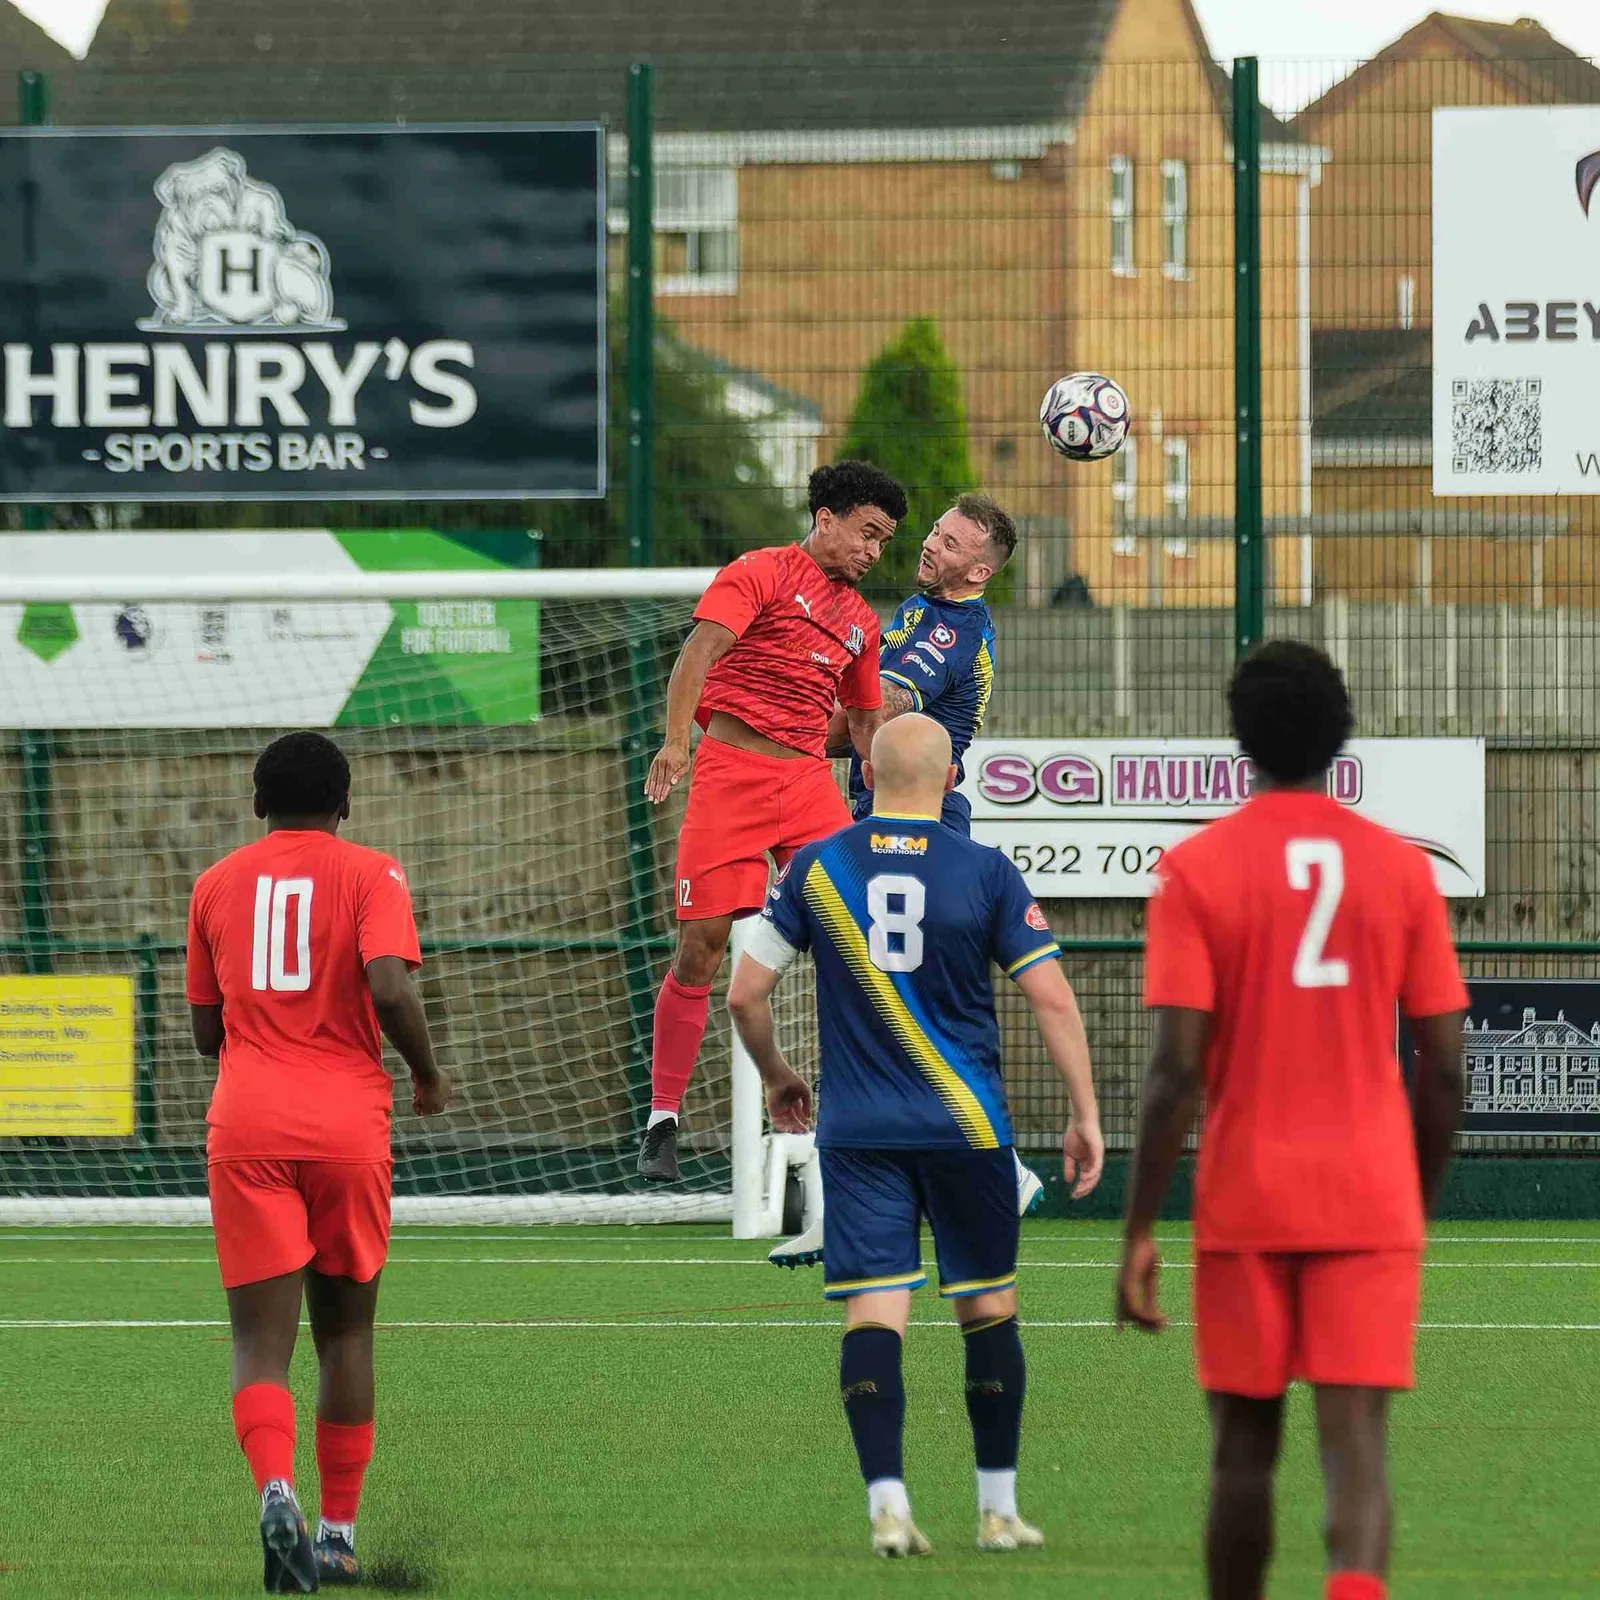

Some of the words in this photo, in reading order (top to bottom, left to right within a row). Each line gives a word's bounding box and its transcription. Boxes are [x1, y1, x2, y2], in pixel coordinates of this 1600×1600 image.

[220, 247, 260, 295] H
[3, 337, 478, 429] HENRY'S
[978, 754, 1102, 804] SG
[1113, 757, 1252, 803] HAULAG
[870, 833, 928, 851] MKM
[872, 847, 926, 856] SCUNTHORPE
[997, 845, 1081, 873] 522
[679, 878, 693, 906] 12
[1285, 838, 1349, 988] 2
[252, 875, 314, 992] 10
[867, 874, 926, 973] 8
